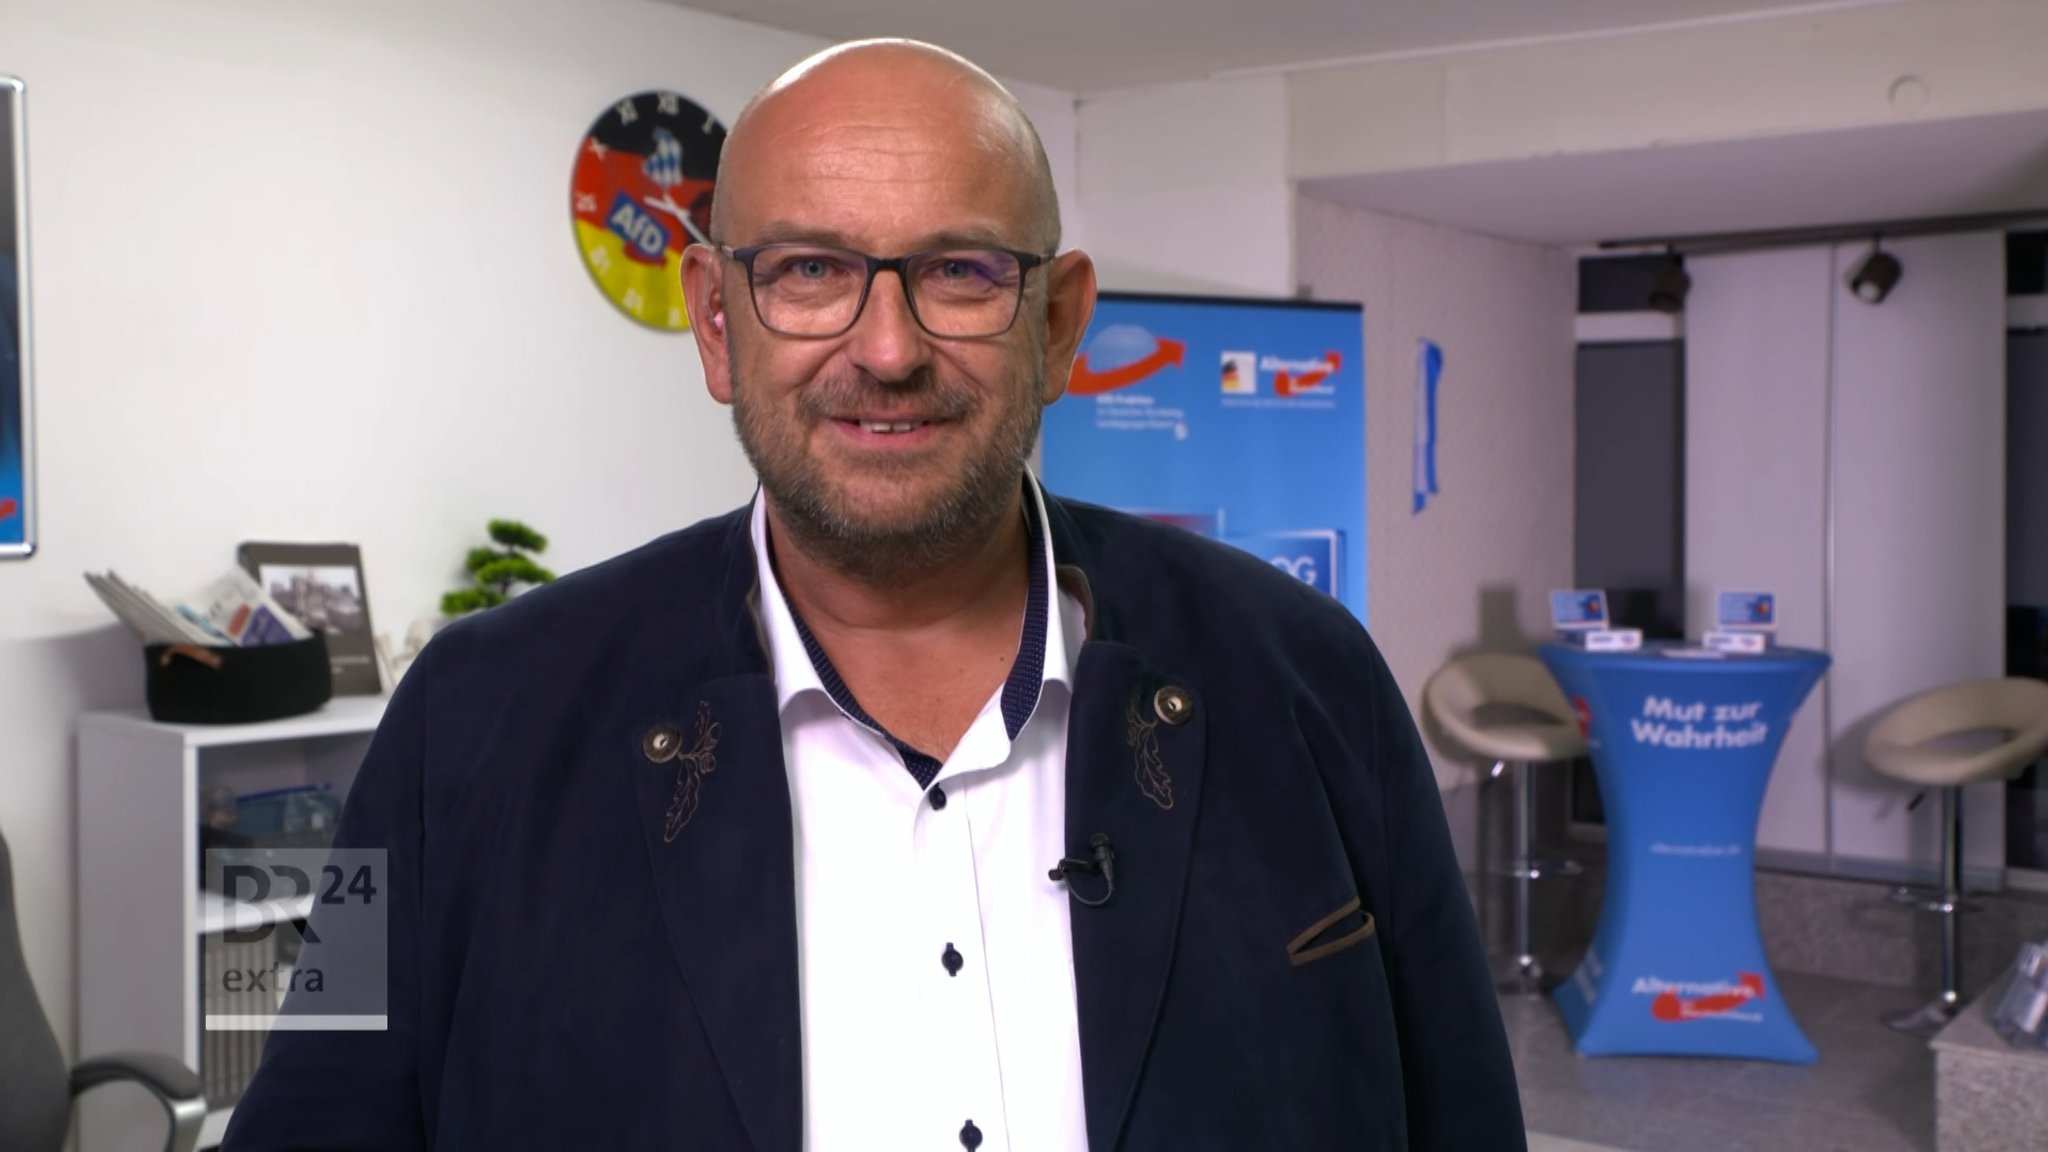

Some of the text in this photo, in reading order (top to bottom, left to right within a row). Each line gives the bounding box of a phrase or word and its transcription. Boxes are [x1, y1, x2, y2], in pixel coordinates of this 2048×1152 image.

[611, 203, 662, 254] AfD
[1643, 695, 1763, 722] Mut zur
[1630, 717, 1769, 750] Wahrheit
